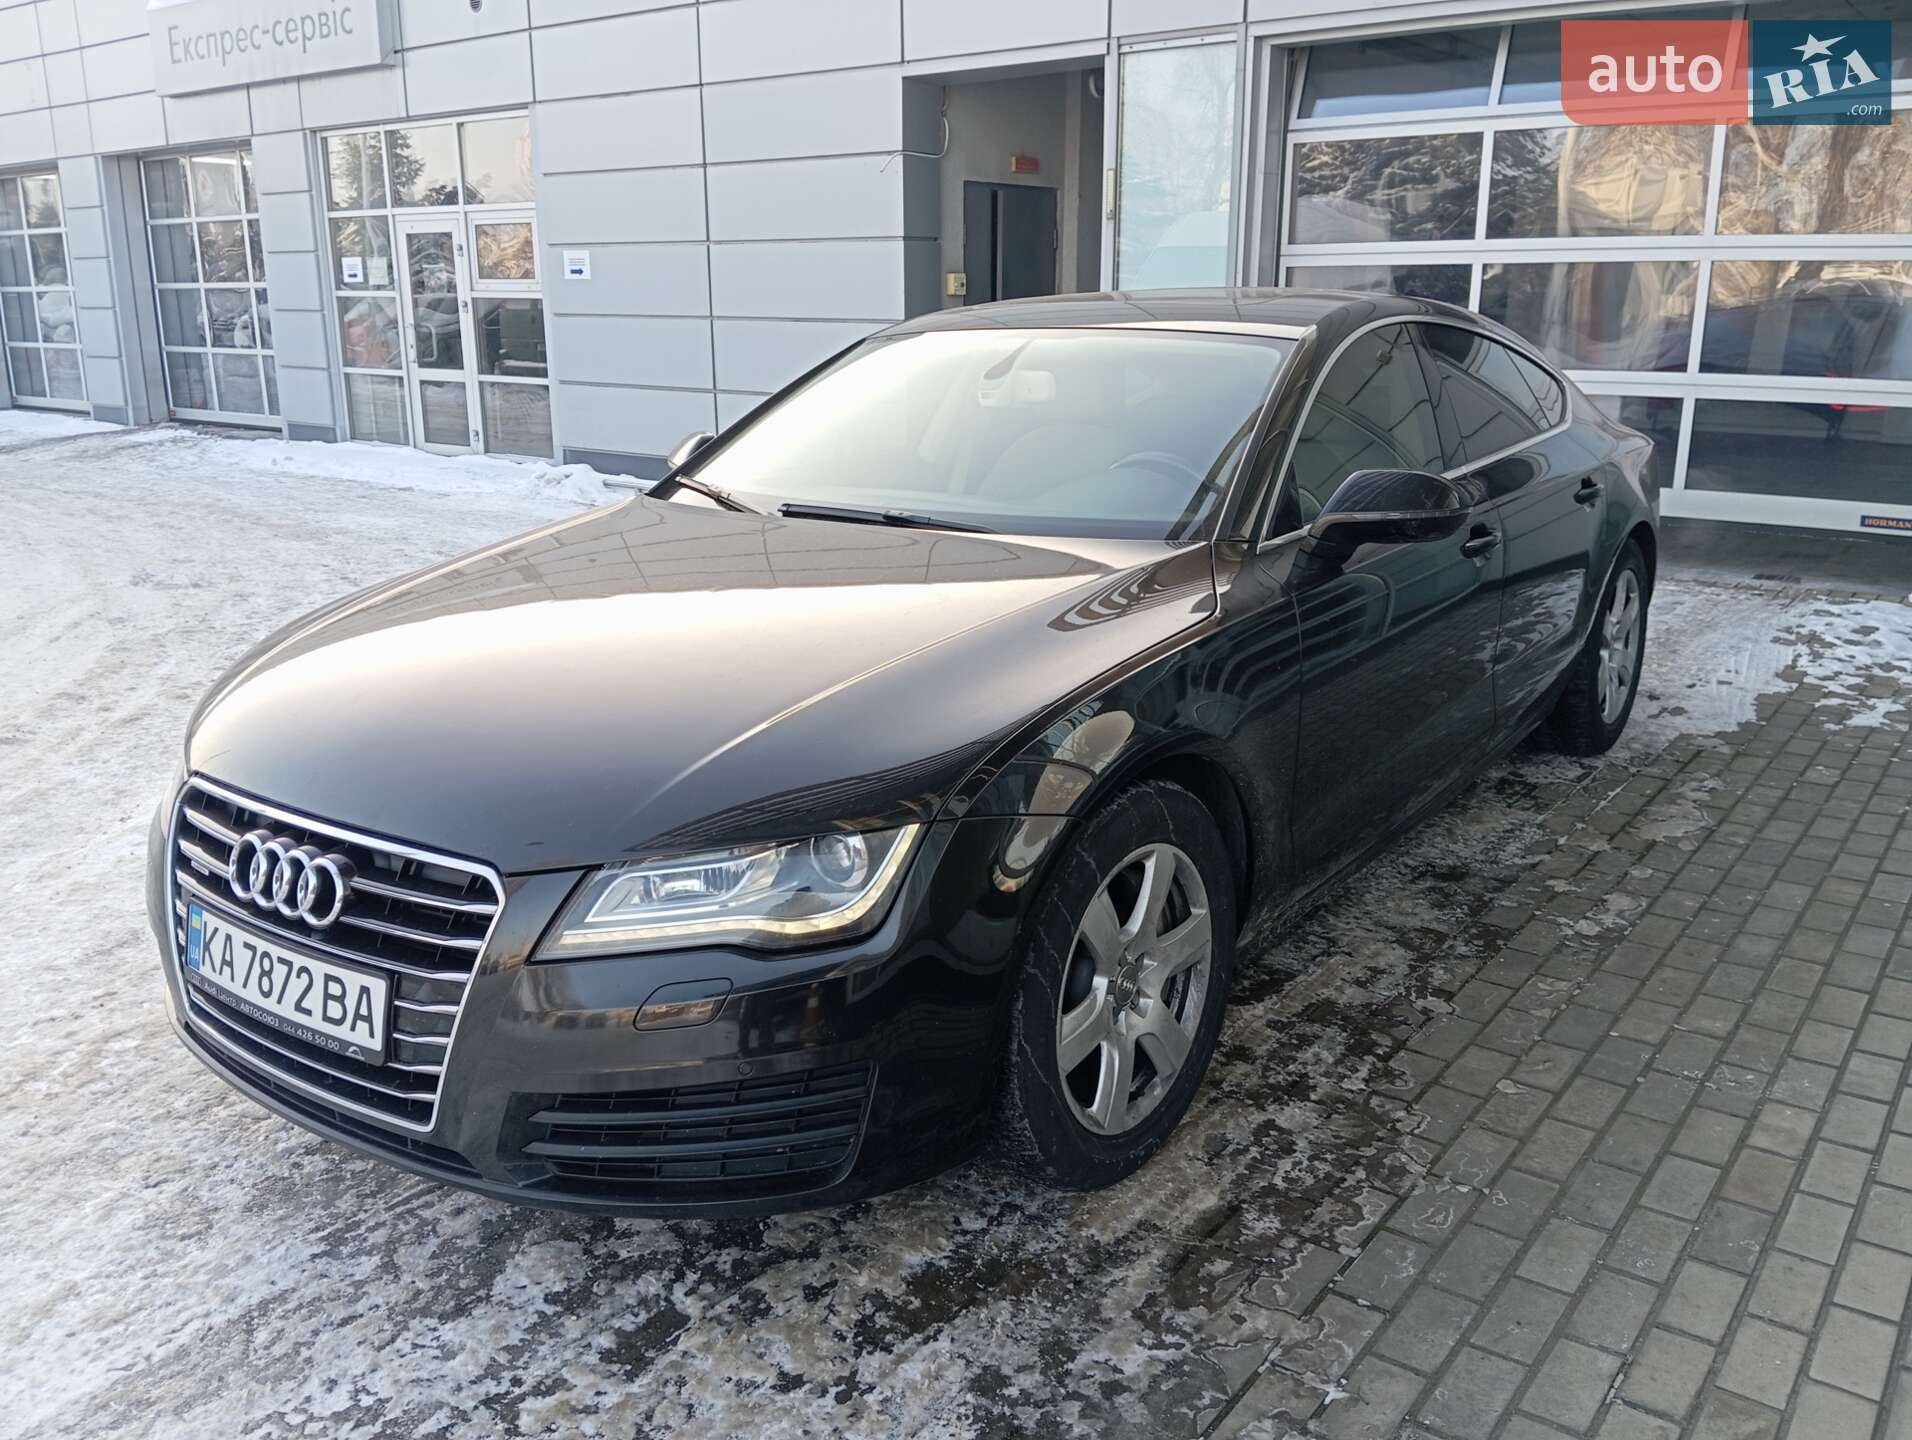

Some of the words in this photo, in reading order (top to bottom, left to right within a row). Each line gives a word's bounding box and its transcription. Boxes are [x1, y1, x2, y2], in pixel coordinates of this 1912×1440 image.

[167, 0, 353, 67] Експрес-сервіс
[190, 943, 200, 959] UA
[242, 940, 313, 1018] 7872
[297, 1028, 314, 1041] 426
[329, 1039, 340, 1050] 00
